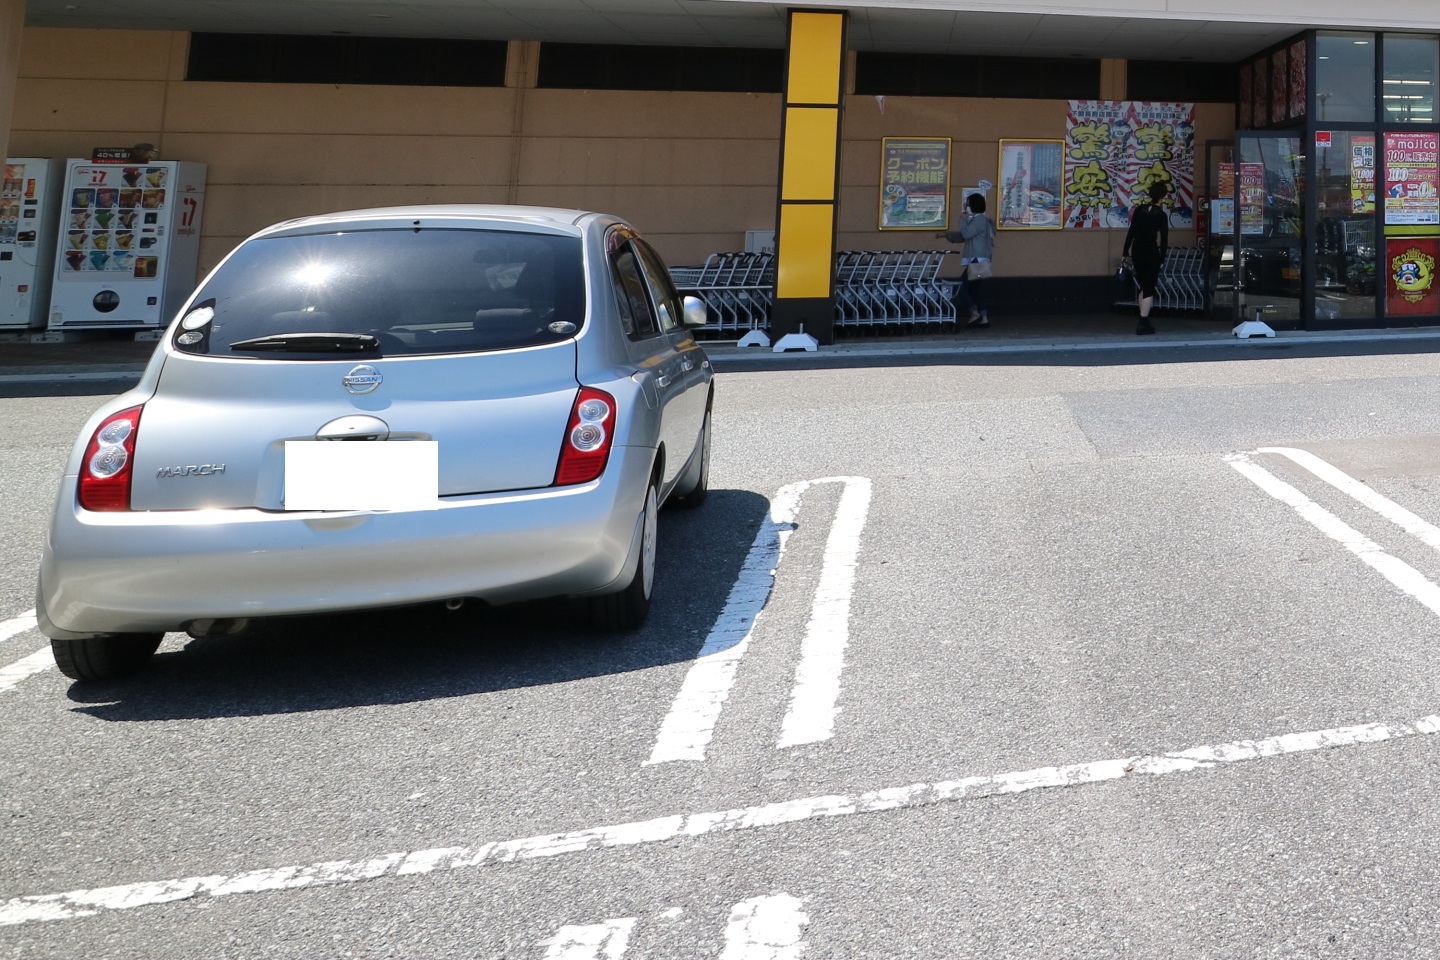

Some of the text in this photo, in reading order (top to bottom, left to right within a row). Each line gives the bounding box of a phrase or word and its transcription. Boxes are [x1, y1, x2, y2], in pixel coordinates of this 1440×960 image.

[1353, 146, 1373, 157] 価格
[1387, 150, 1406, 163] 100
[887, 157, 945, 170] クーポン
[887, 170, 945, 184] 予約機能
[1388, 167, 1409, 182] 100
[156, 463, 226, 479] MARCH
